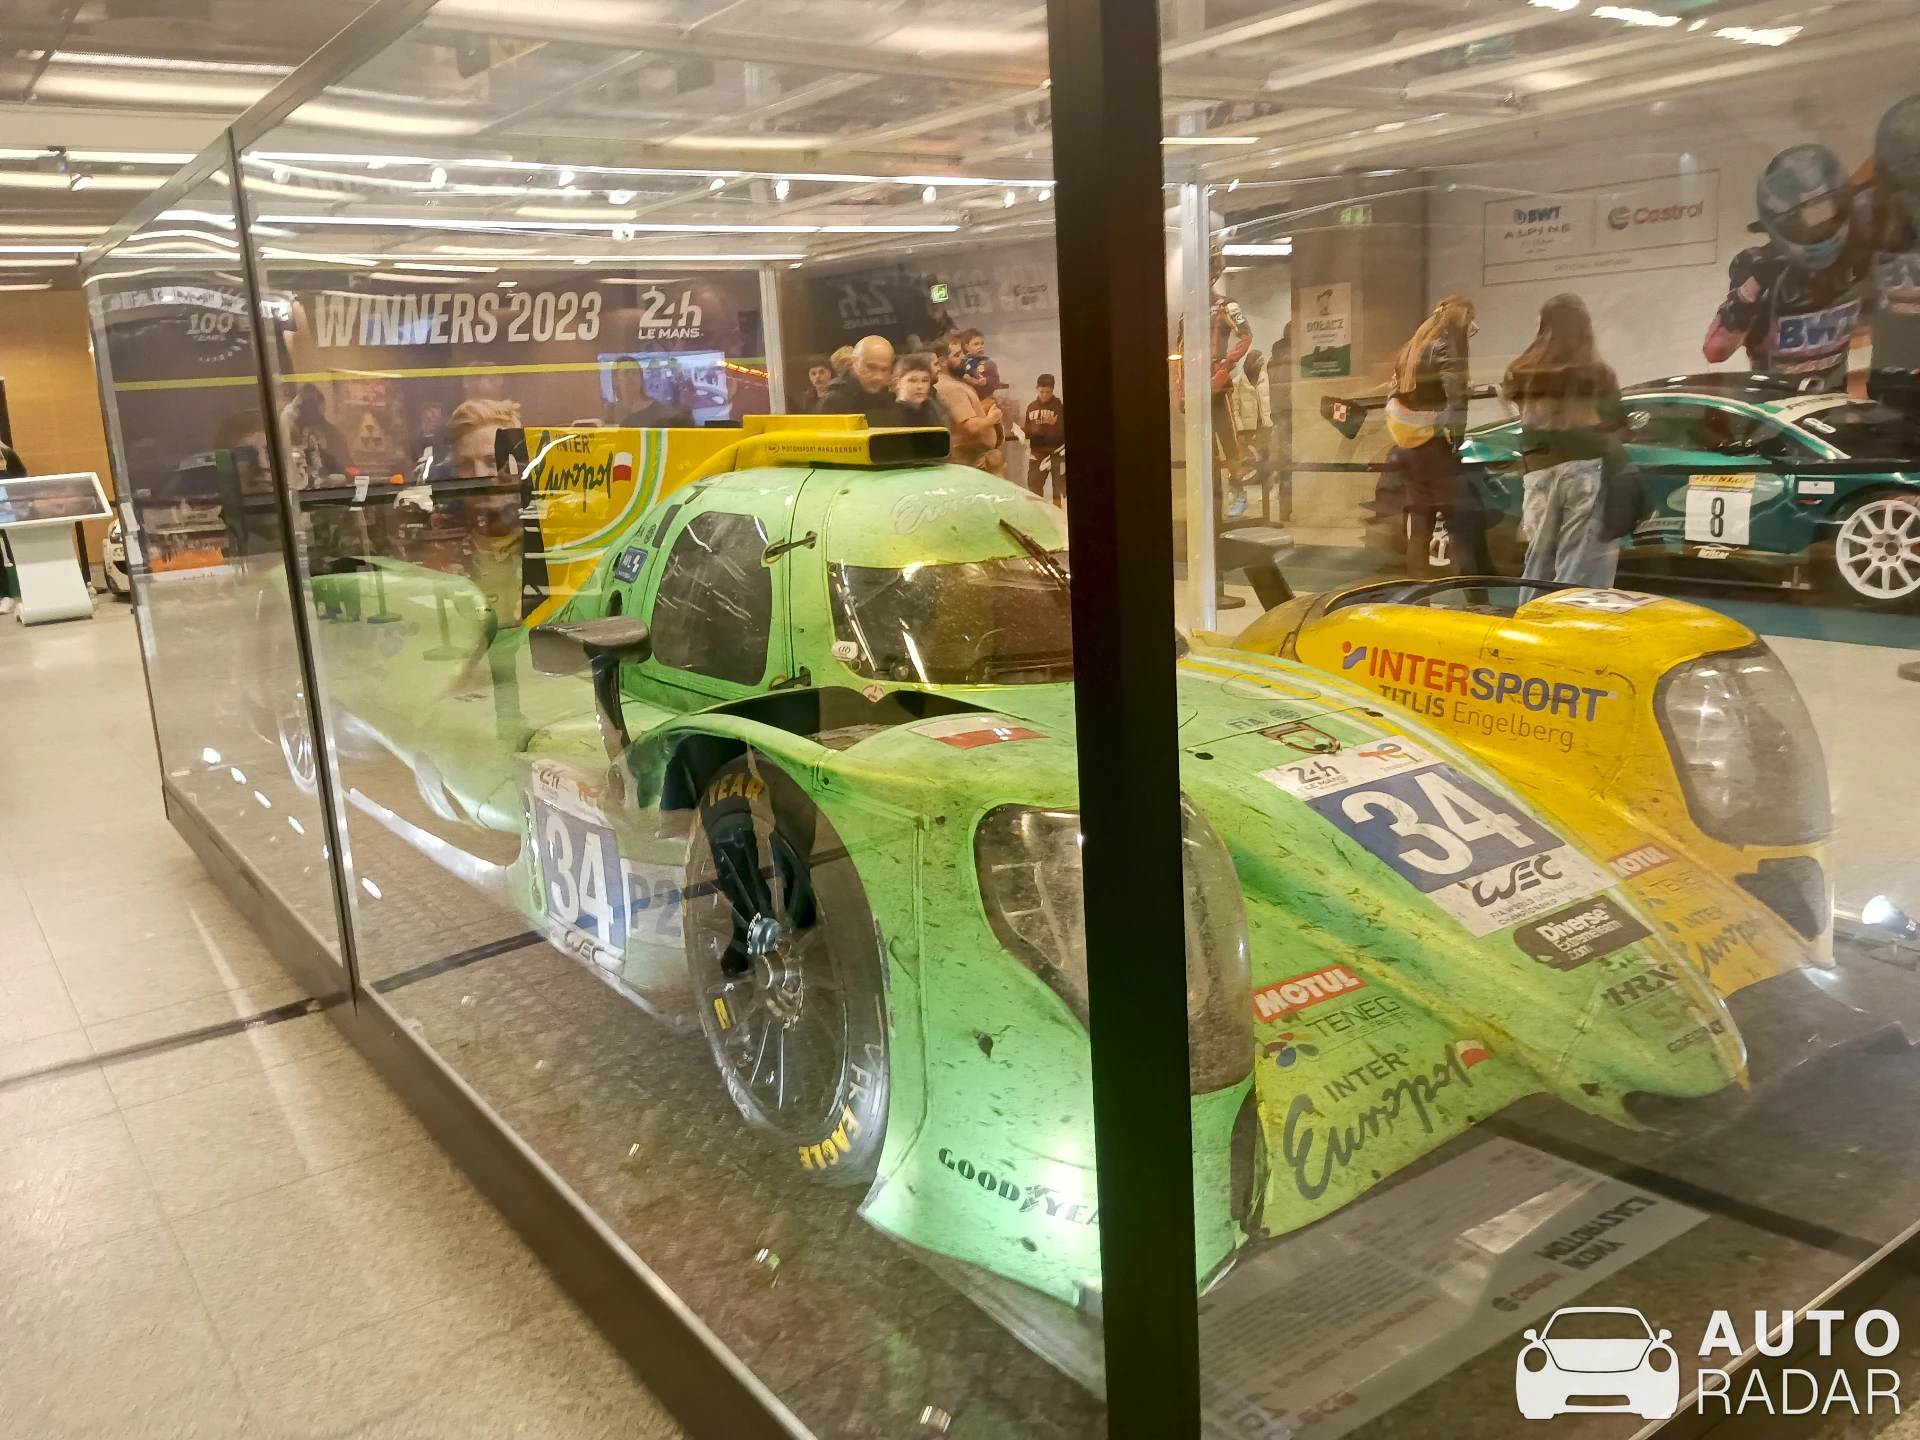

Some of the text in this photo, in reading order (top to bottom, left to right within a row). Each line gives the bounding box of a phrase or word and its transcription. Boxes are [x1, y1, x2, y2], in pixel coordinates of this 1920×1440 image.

[1504, 223, 1571, 238] ALPINE
[1528, 206, 1561, 221] BWT
[1633, 201, 1704, 226] Castrol
[187, 313, 234, 335] 100
[315, 291, 602, 348] WINNERS 2023
[638, 286, 702, 328] 24h
[1779, 300, 1861, 350] BWT
[638, 327, 700, 340] LE MANS
[781, 445, 815, 453] MOTORSPORT
[1701, 475, 1754, 486] DUNLOP
[1710, 497, 1725, 538] 8
[1369, 646, 1608, 721] INTERSPORT
[1453, 702, 1574, 753] Engelberg
[709, 773, 765, 807] YEAR
[1288, 761, 1340, 784] 24h
[1342, 772, 1536, 874] 34
[546, 814, 614, 947] 34
[1472, 854, 1564, 907] WEC
[628, 872, 682, 937] P2
[1499, 898, 1559, 926] CHAMPIONSHIP
[1536, 906, 1610, 941] Diverse
[1254, 968, 1359, 1018] MOTUL
[1305, 995, 1401, 1037] TENEG
[1323, 1052, 1409, 1103] INTER
[799, 1104, 862, 1170] EAGLE
[1283, 1043, 1474, 1200] Europol
[938, 1147, 1099, 1226] GOODYEA
